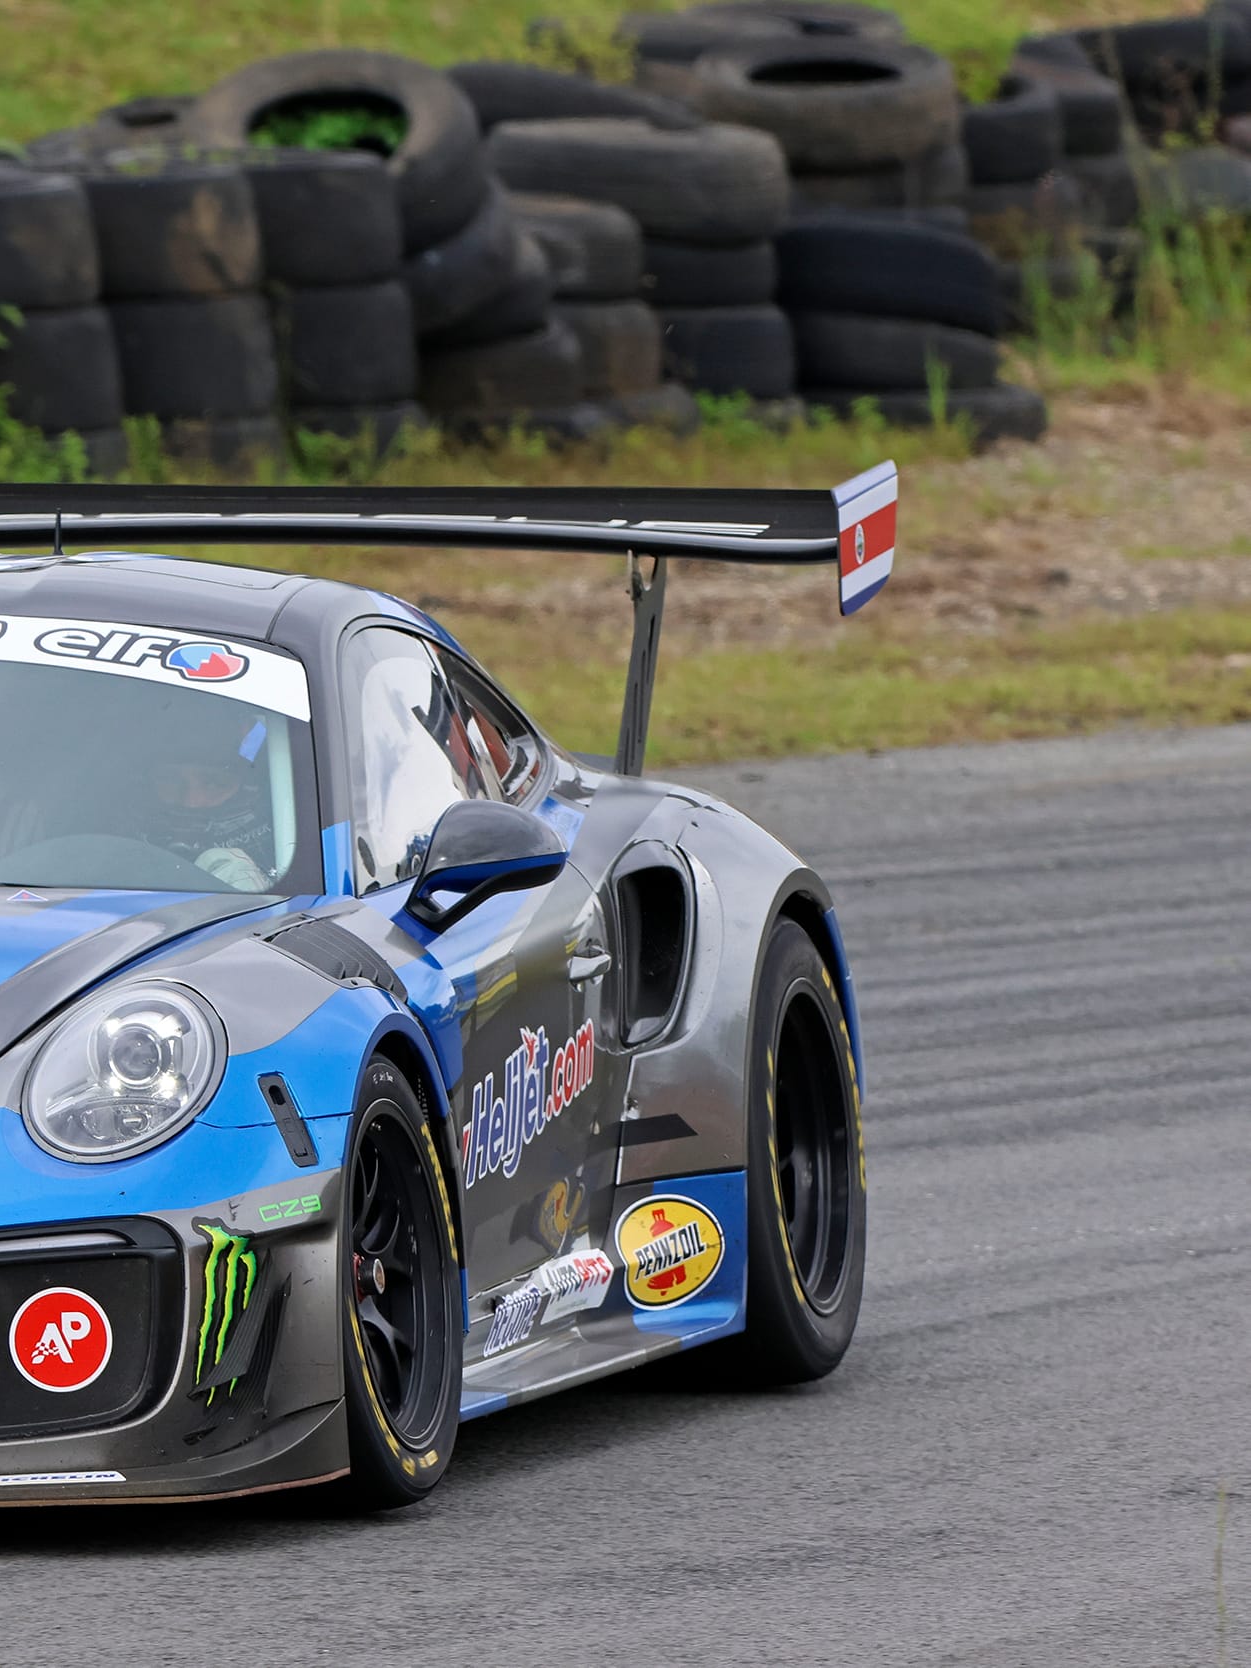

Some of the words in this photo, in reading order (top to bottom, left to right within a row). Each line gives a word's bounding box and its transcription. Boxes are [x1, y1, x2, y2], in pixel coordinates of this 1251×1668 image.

[33, 628, 180, 667] elf
[463, 1018, 595, 1190] HeliJet.com
[258, 1194, 321, 1223] CZ9
[633, 1220, 706, 1283] PENNZOIL
[31, 1311, 92, 1364] AP
